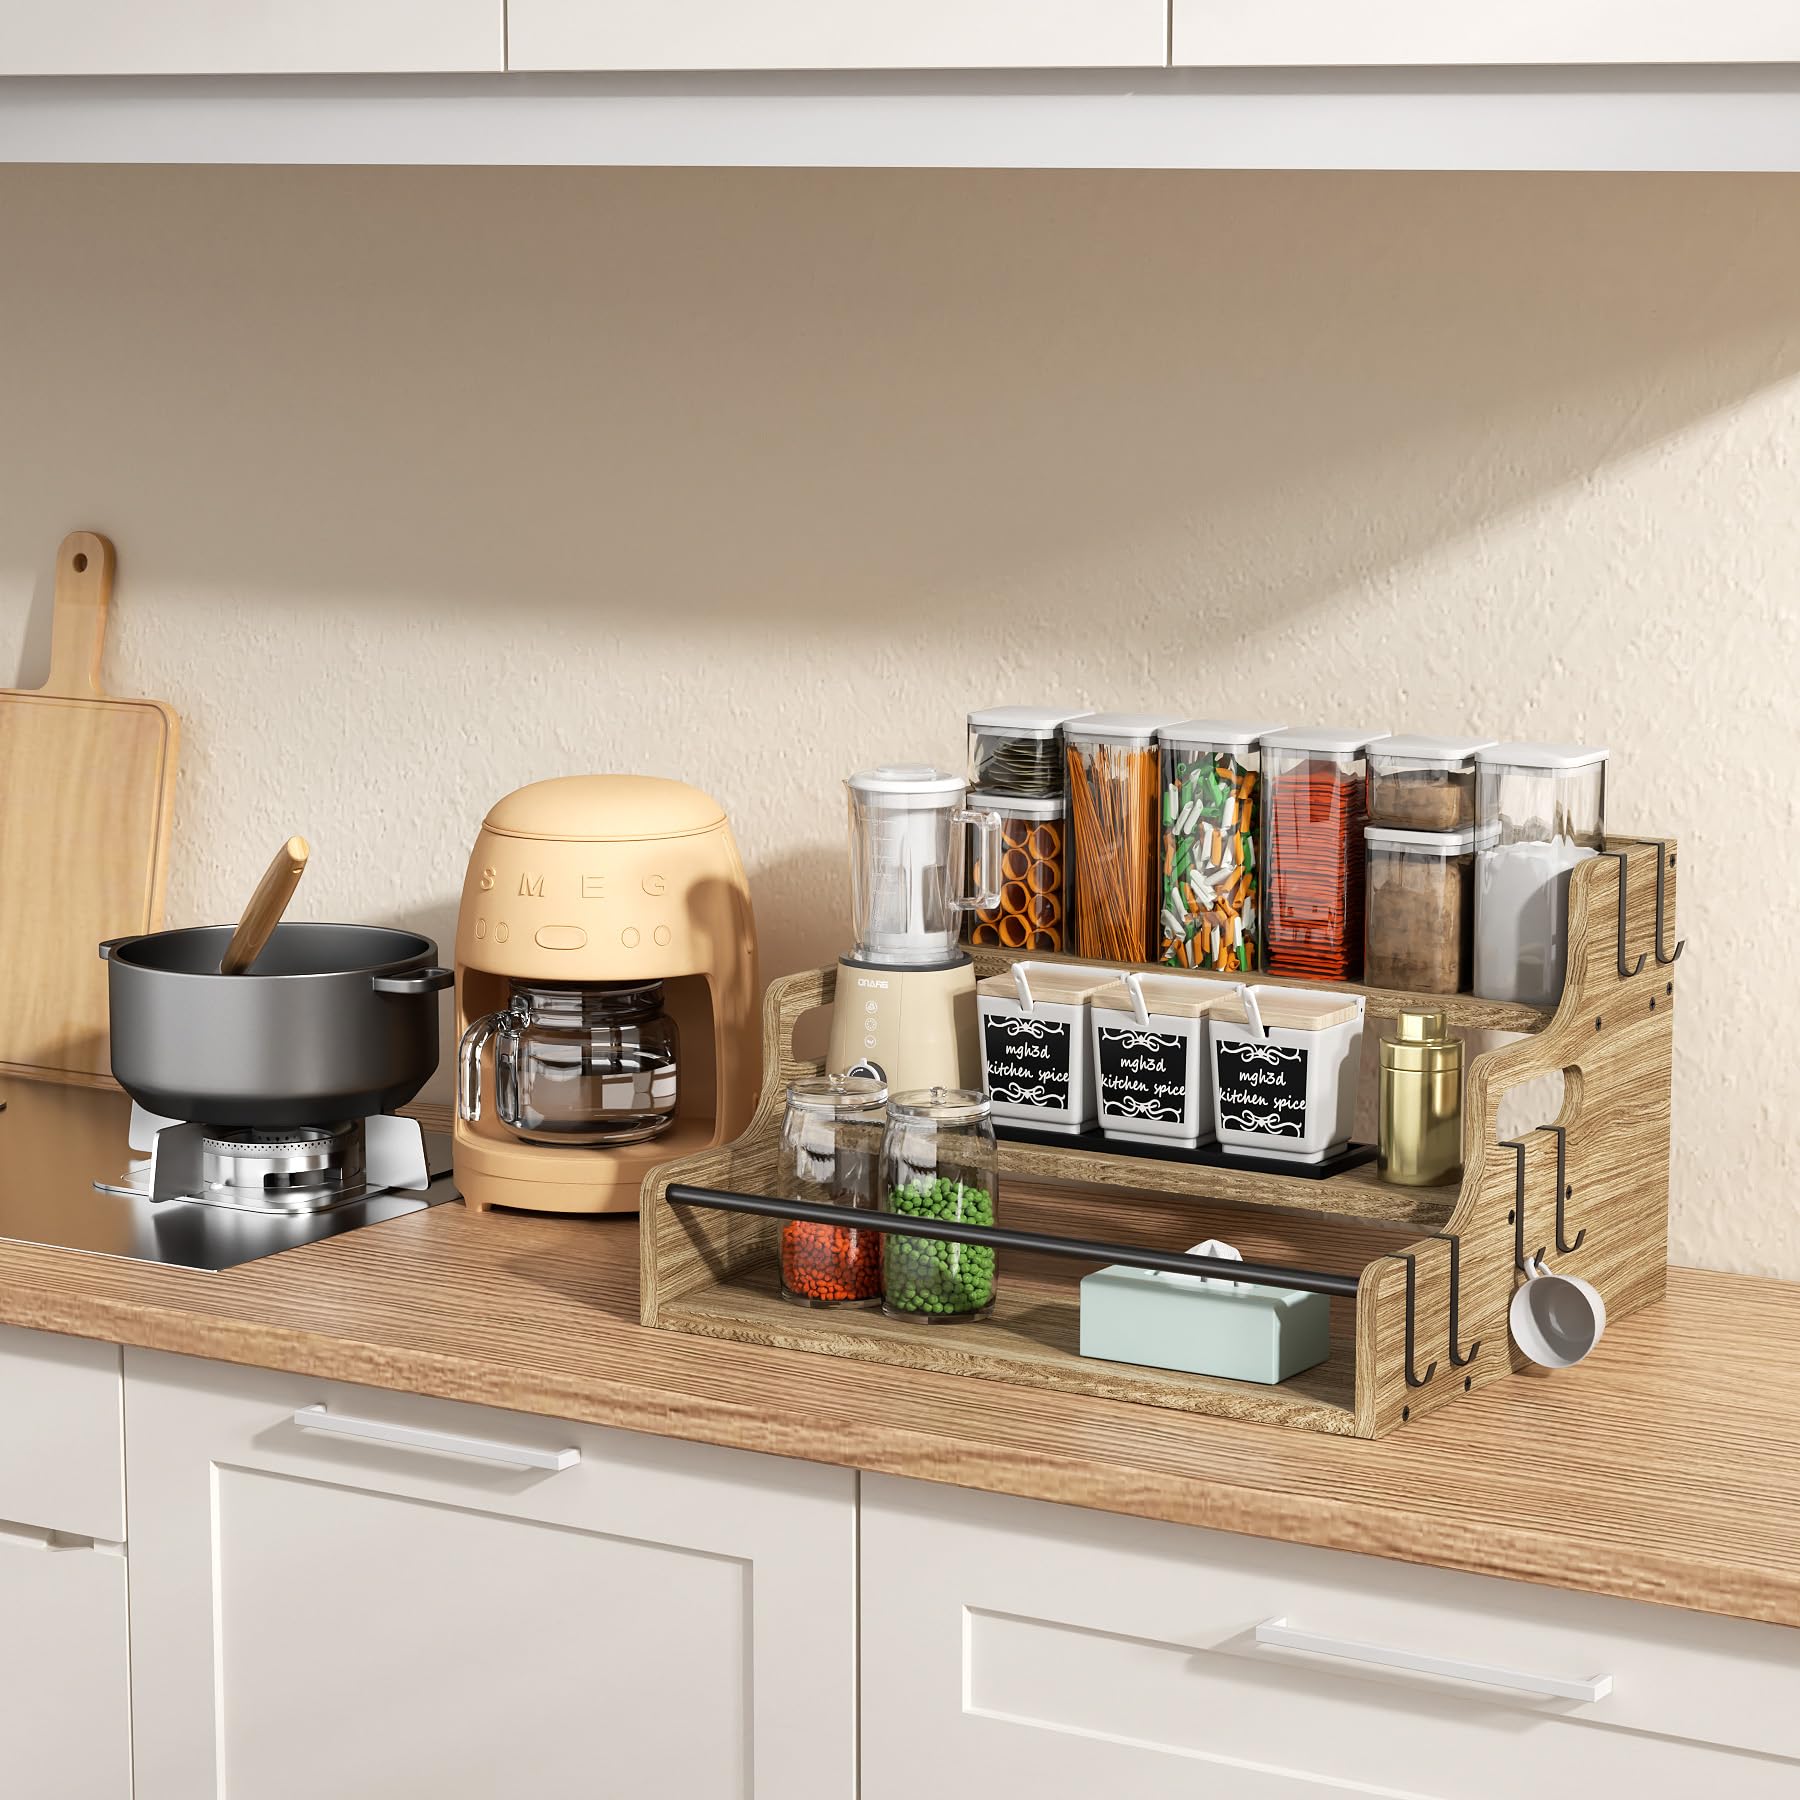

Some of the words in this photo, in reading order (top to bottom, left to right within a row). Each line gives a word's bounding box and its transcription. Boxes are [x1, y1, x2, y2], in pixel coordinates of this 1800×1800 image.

[479, 866, 665, 899] SMEG
[1005, 1041, 1050, 1059] mgh3d
[987, 1060, 1034, 1077] kitchen
[1038, 1068, 1070, 1084] spice
[1120, 1054, 1166, 1073] mgh3d
[1101, 1073, 1149, 1092] kitchen
[1153, 1081, 1185, 1098] spice
[1239, 1068, 1287, 1087] mgh3d
[1219, 1087, 1269, 1106] kitchen
[1273, 1095, 1306, 1112] spice
